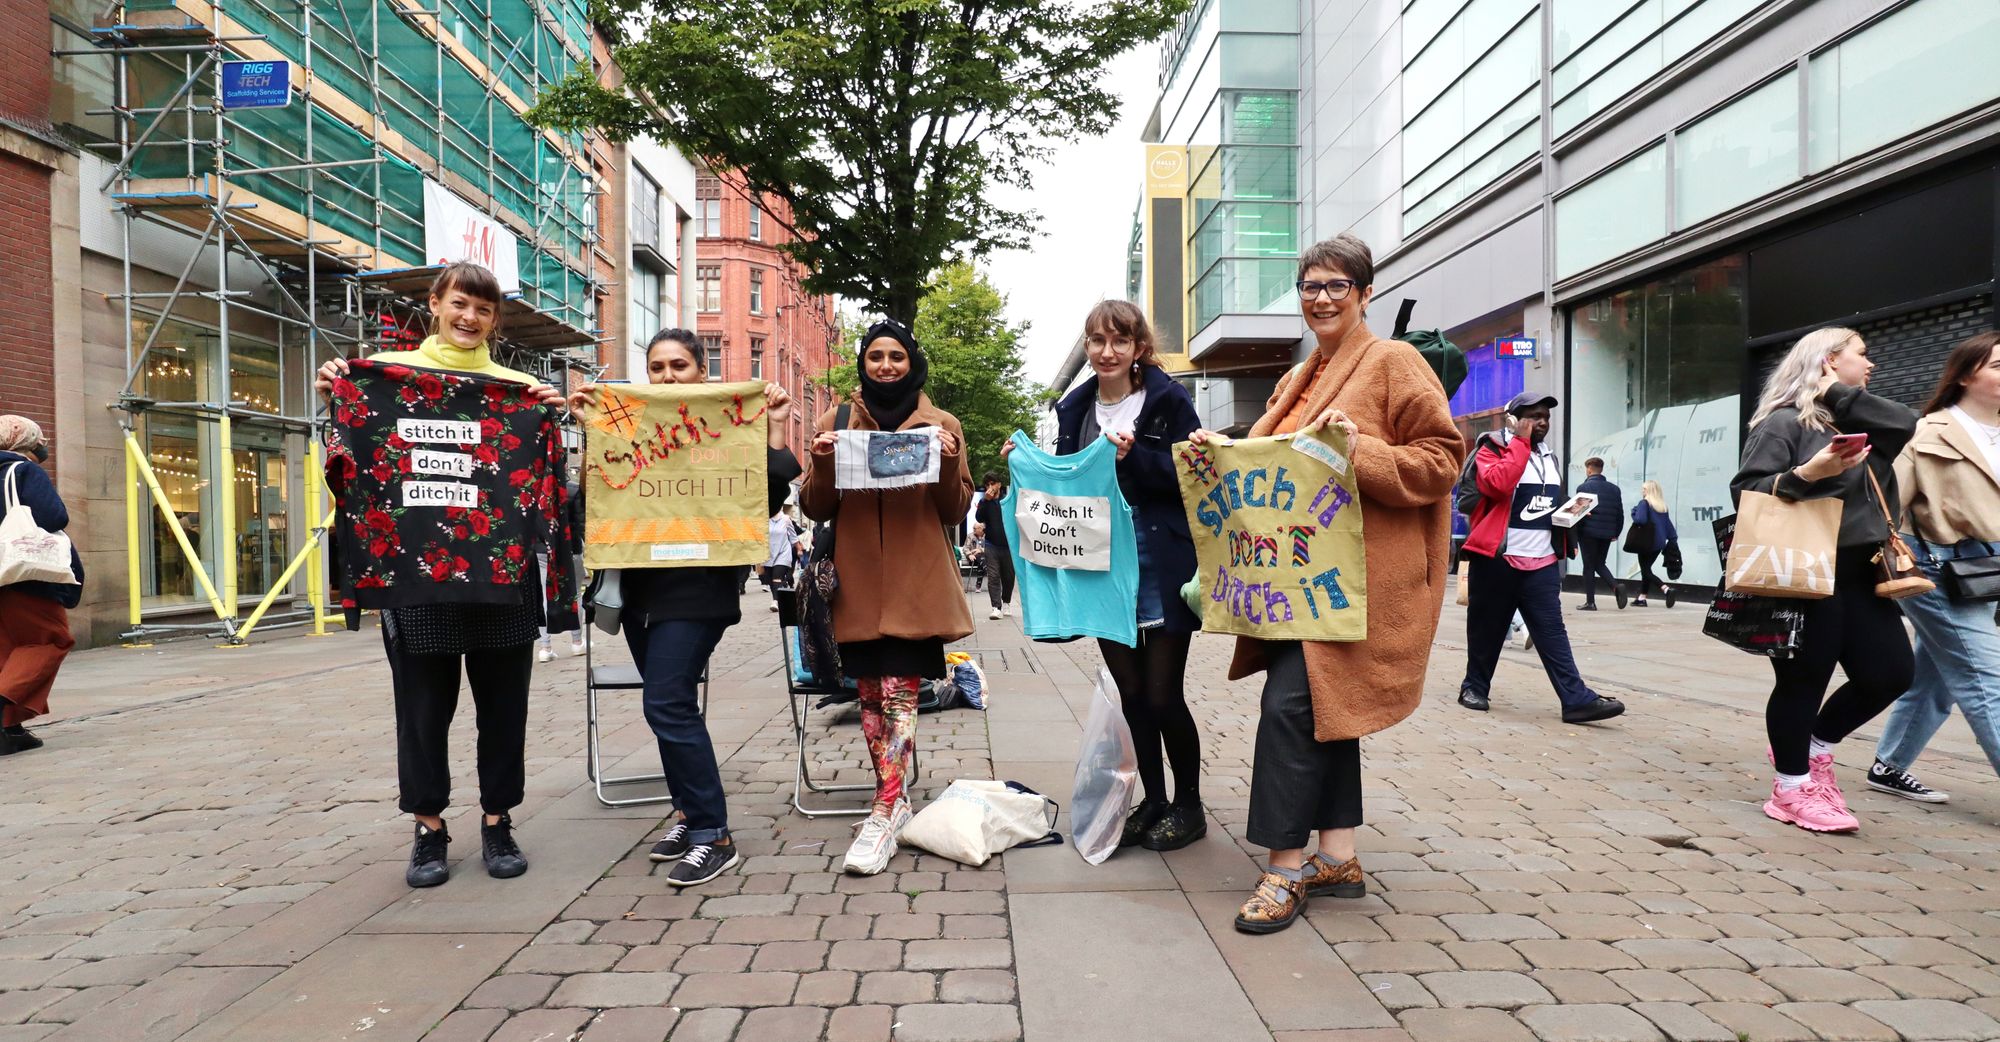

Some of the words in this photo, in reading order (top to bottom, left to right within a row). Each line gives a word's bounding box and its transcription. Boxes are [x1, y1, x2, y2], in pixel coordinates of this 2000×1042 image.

[241, 63, 273, 74] RIGG
[239, 76, 271, 87] TECH
[227, 89, 258, 98] Scaffolding
[259, 88, 285, 96] Services
[462, 216, 496, 274] H&M
[1499, 341, 1533, 356] METRO
[404, 424, 456, 439] stitch
[462, 426, 474, 440] it
[1699, 426, 1727, 444] TMT
[417, 455, 465, 472] don't
[409, 485, 455, 500] ditch
[459, 487, 471, 502] it
[639, 478, 705, 498] DITCH
[1043, 502, 1078, 519] Stitch
[1083, 506, 1094, 519] It
[1691, 505, 1723, 522] TMT
[1040, 521, 1077, 538] Don't
[1033, 539, 1068, 556] Ditch
[1073, 544, 1084, 557] It
[1732, 543, 1836, 593] ZARA
